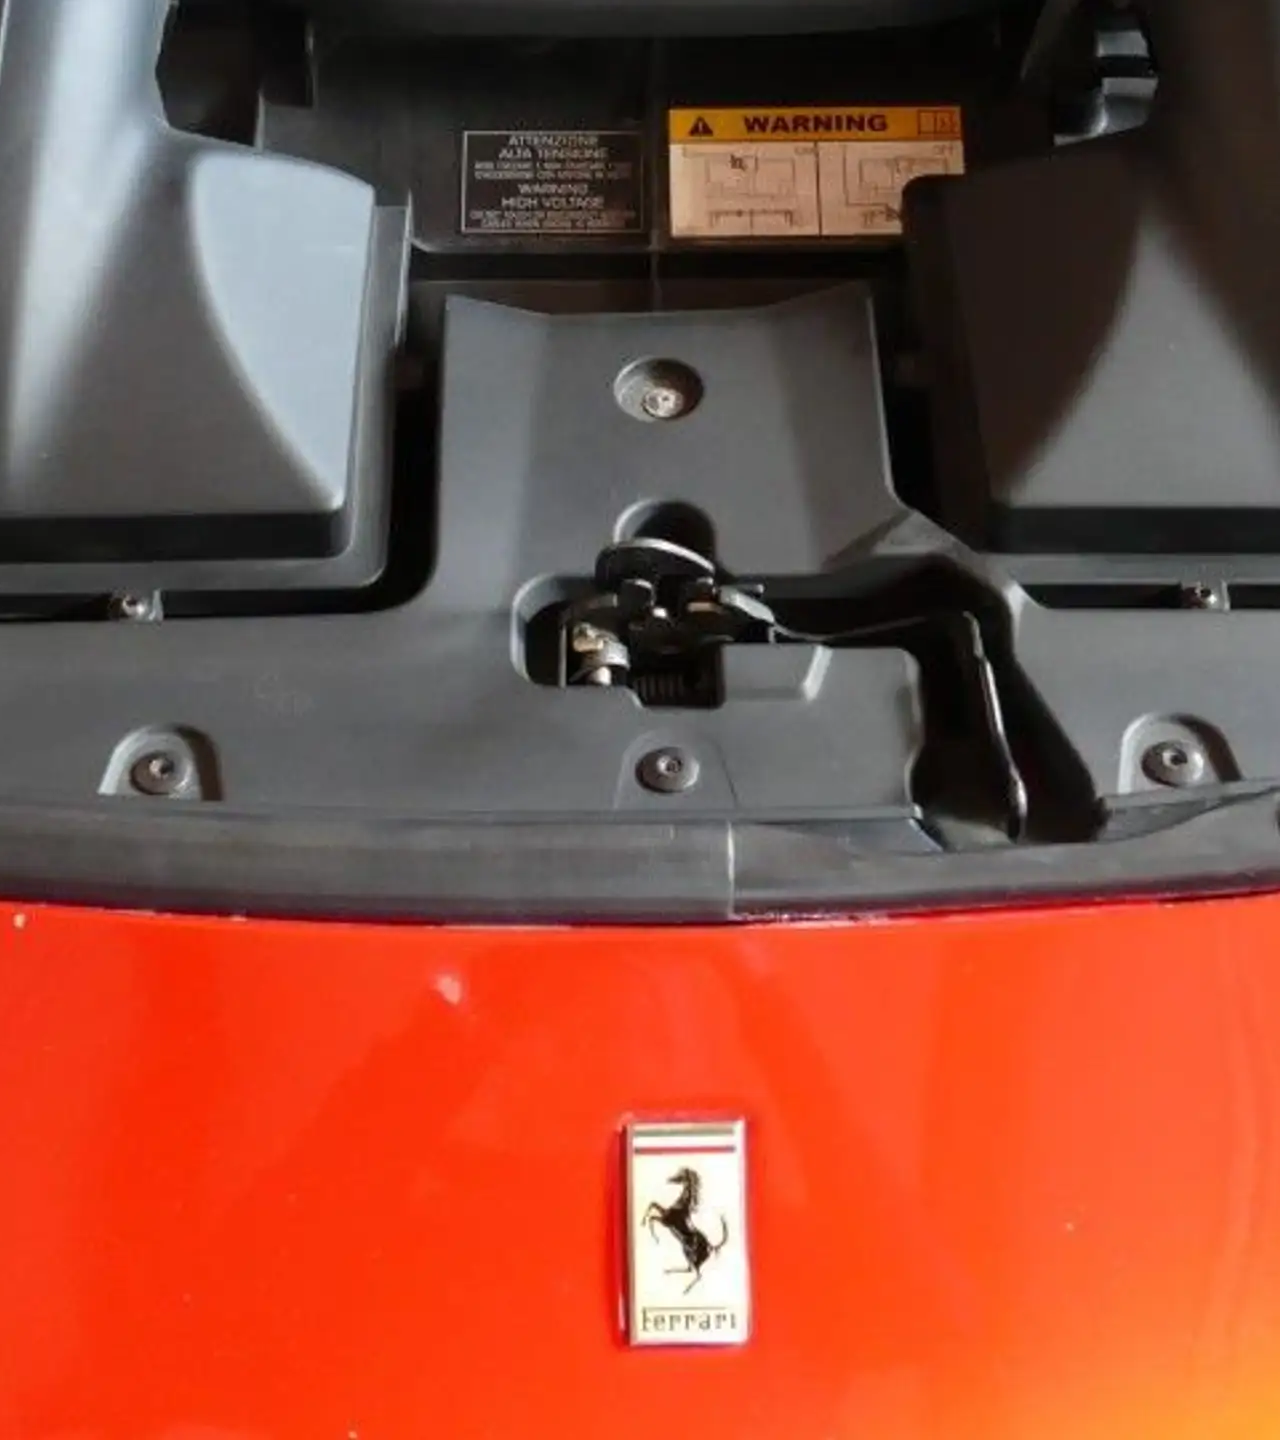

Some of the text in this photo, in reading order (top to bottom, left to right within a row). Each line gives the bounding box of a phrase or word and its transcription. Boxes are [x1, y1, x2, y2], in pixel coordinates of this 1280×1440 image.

[743, 114, 888, 132] WARNING
[508, 136, 599, 146] ATTENZIONE
[498, 148, 533, 159] ALTA
[518, 184, 589, 195] WARNING
[501, 197, 605, 209] HIGH VOLTAGE
[641, 1306, 737, 1333] Ferrari
